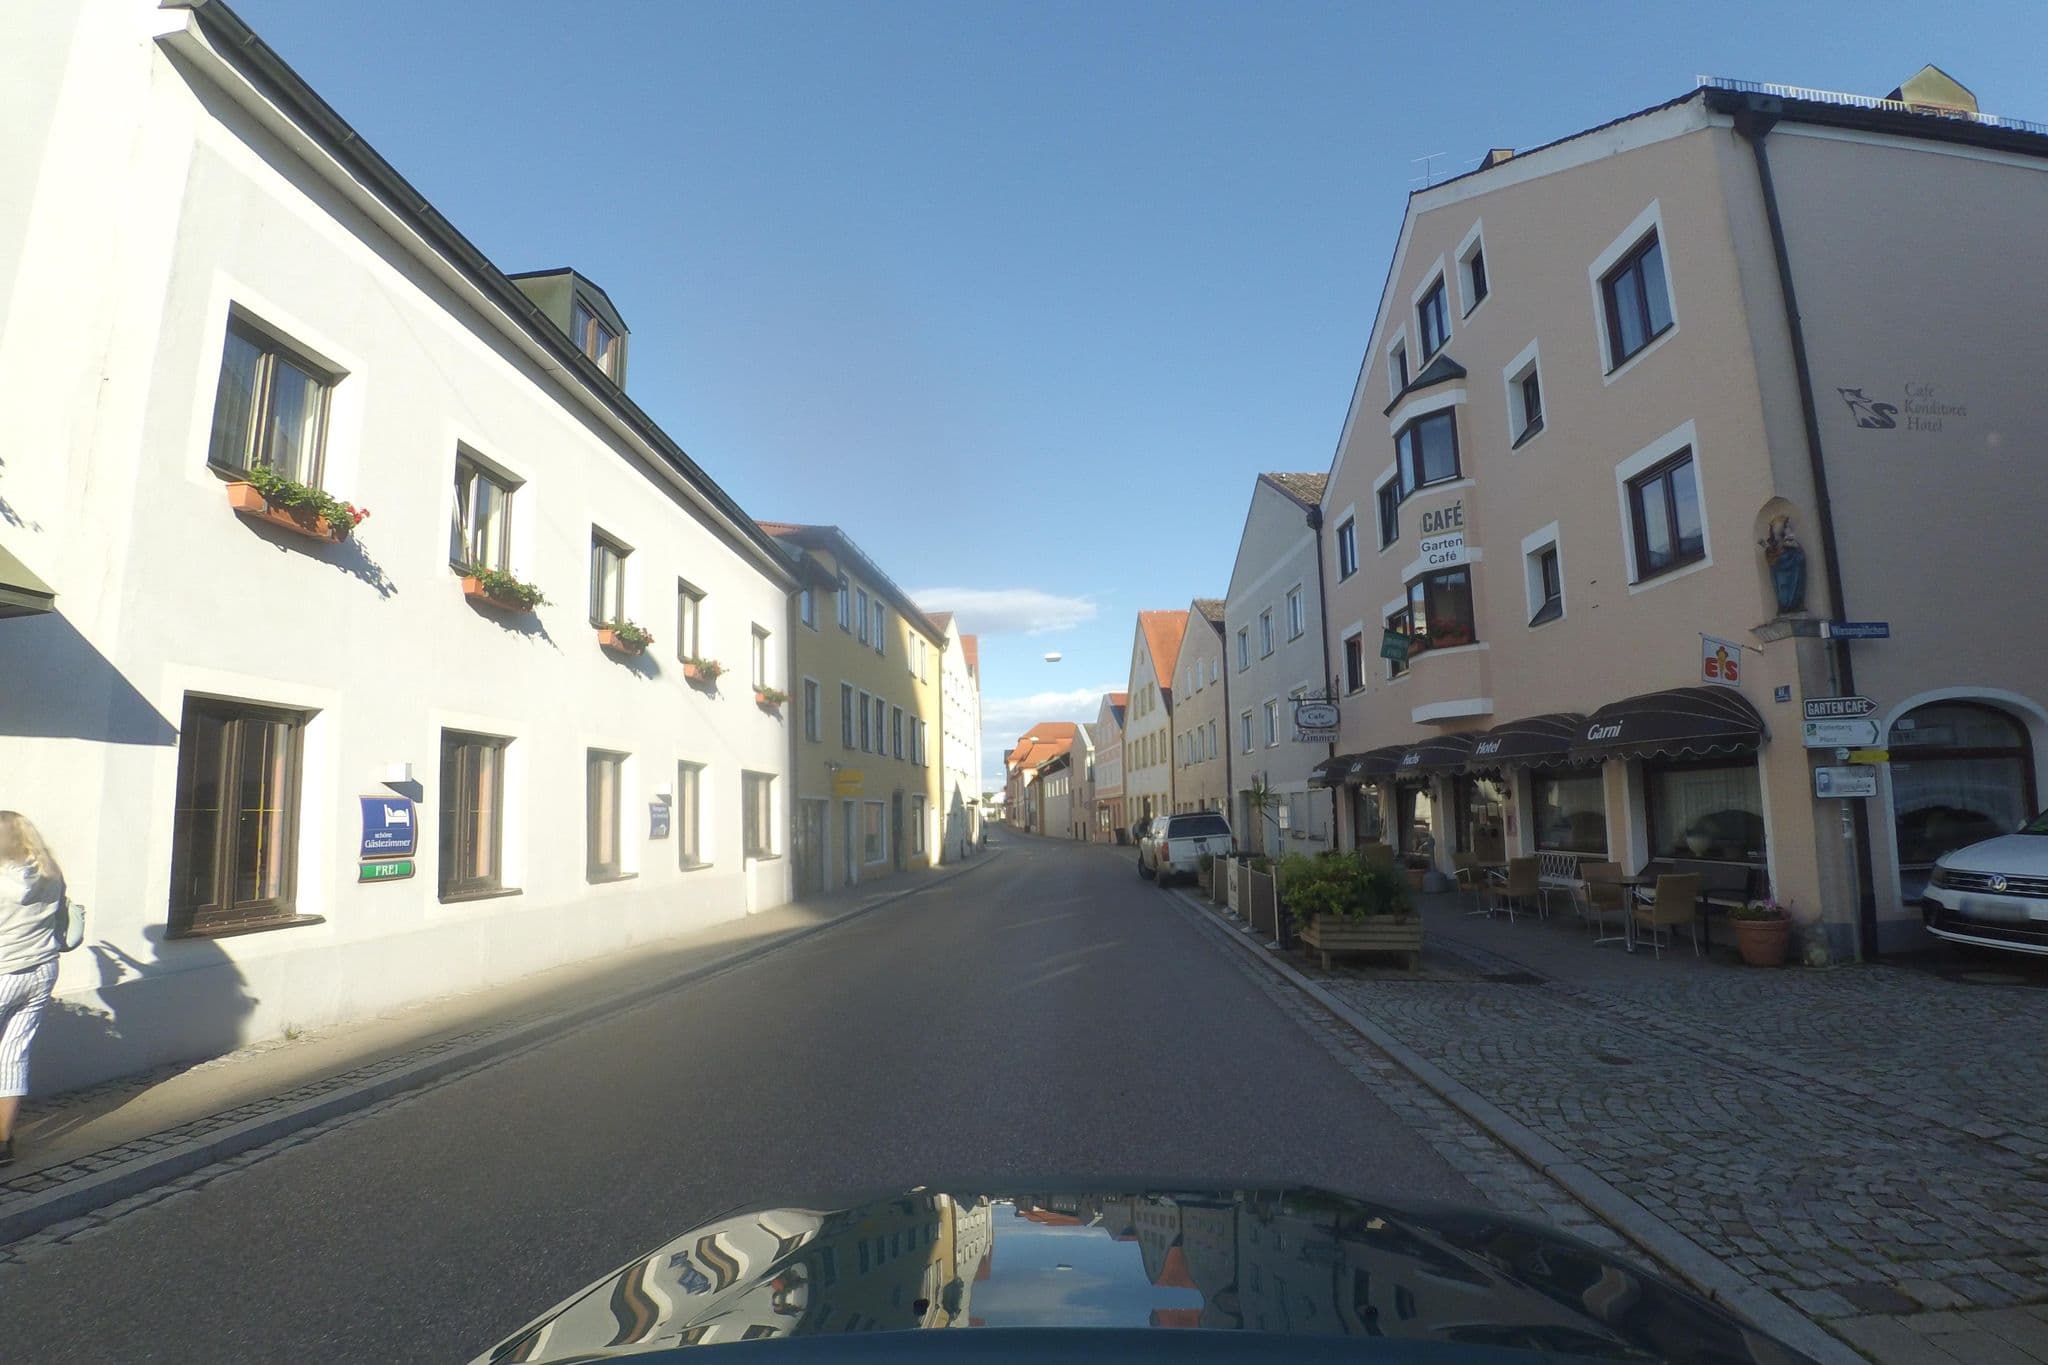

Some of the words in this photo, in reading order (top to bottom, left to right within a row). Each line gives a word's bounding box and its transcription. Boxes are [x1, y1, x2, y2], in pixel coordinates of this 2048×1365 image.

[1907, 416, 1943, 432] Hotel
[1423, 501, 1463, 532] CAFÉ
[1421, 538, 1463, 552] Garten
[1429, 551, 1457, 564] Café
[1807, 702, 1844, 715] GARTEN
[1845, 700, 1868, 713] CAFE
[1588, 719, 1624, 740] Garni
[1300, 733, 1337, 742] Zimmer
[1475, 739, 1502, 754] Hotel
[364, 839, 412, 849] Gästezimmer
[375, 863, 399, 876] FREI
